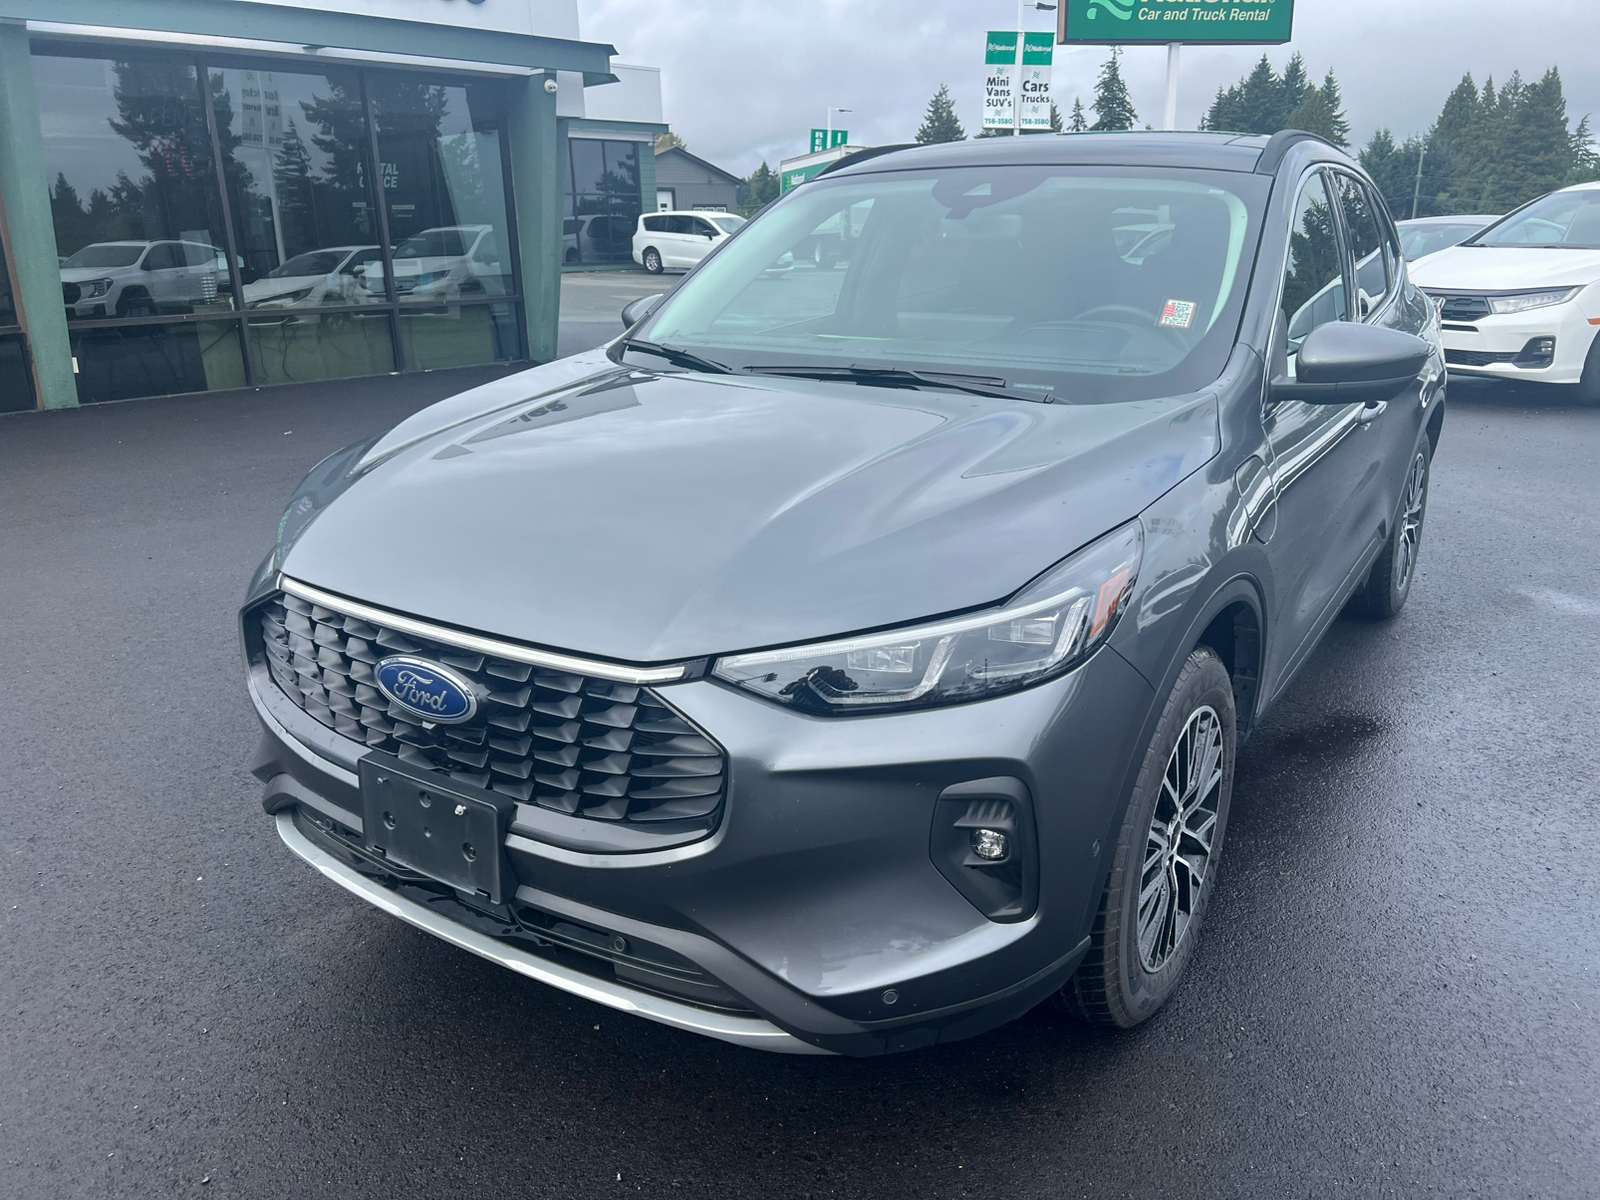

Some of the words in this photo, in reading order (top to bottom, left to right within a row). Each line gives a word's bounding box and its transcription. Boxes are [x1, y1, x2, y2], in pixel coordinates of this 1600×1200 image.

[1138, 7, 1161, 20] Car
[1163, 7, 1187, 21] and
[1192, 8, 1226, 21] Truck
[1229, 8, 1271, 21] Rental
[986, 76, 1009, 87] Mini
[1022, 80, 1049, 92] Cars
[986, 87, 1011, 97] Vans
[986, 98, 1012, 107] SUV's
[1021, 94, 1050, 103] Trucks
[357, 162, 399, 175] RTAL
[394, 670, 448, 711] Ford
